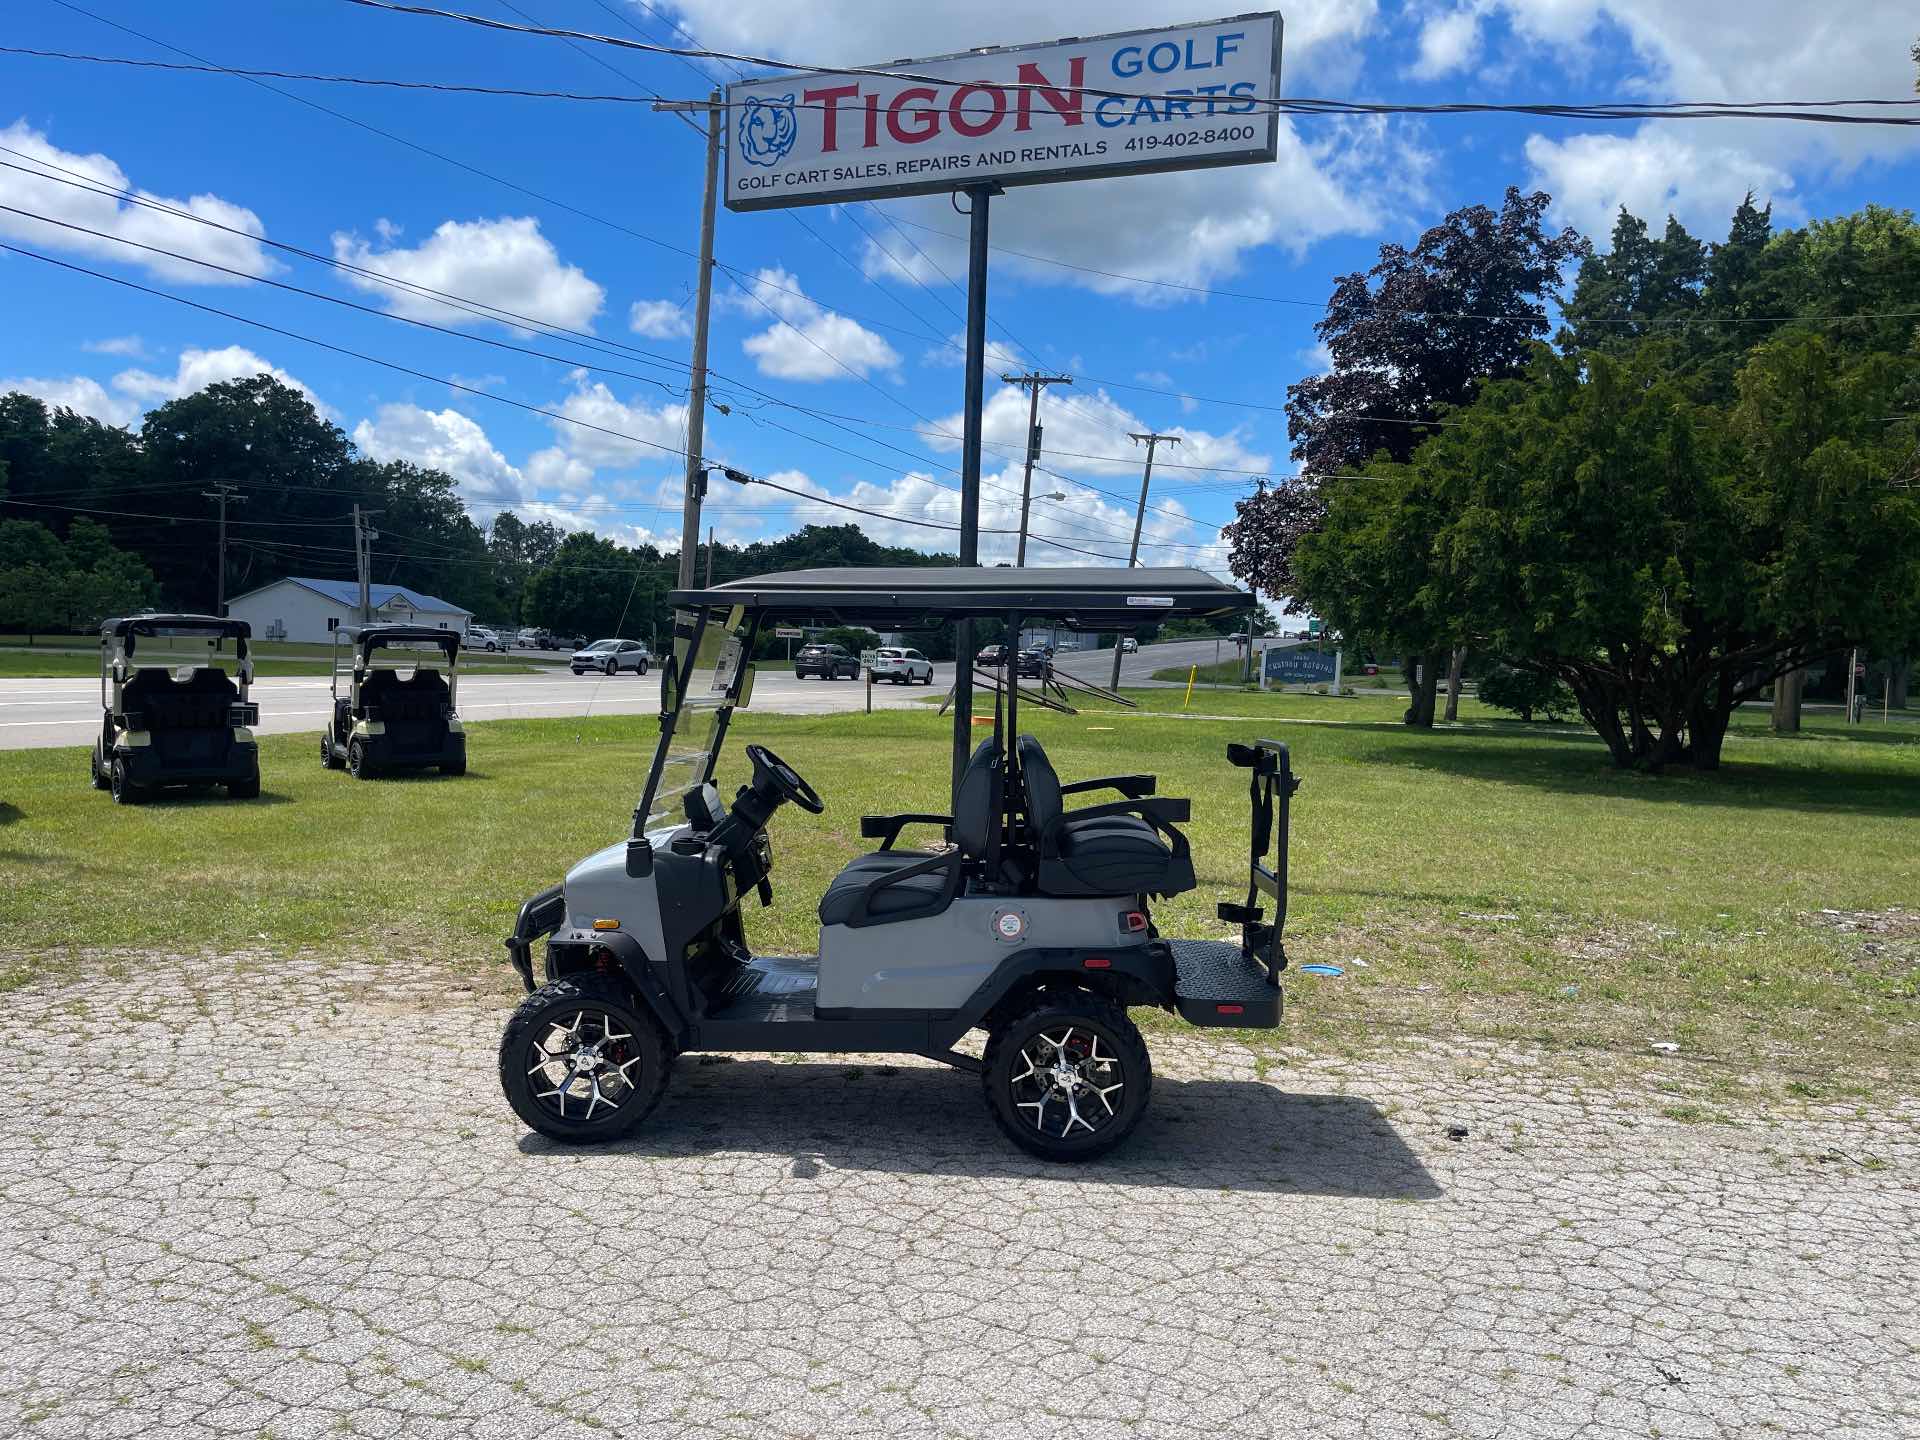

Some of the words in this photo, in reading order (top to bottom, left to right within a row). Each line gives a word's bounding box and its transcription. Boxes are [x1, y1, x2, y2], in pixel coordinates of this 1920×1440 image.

[1111, 32, 1245, 78] GOLF
[803, 56, 1087, 152] TIGON
[1094, 82, 1257, 128] CARTS
[737, 174, 781, 190] GOLF
[784, 169, 830, 186] CART
[833, 163, 892, 181] SALES,
[896, 154, 970, 175] REPAIRS
[975, 150, 1016, 167] AND
[1020, 140, 1107, 162] RENTALS
[1124, 125, 1255, 151] 419-402-8400
